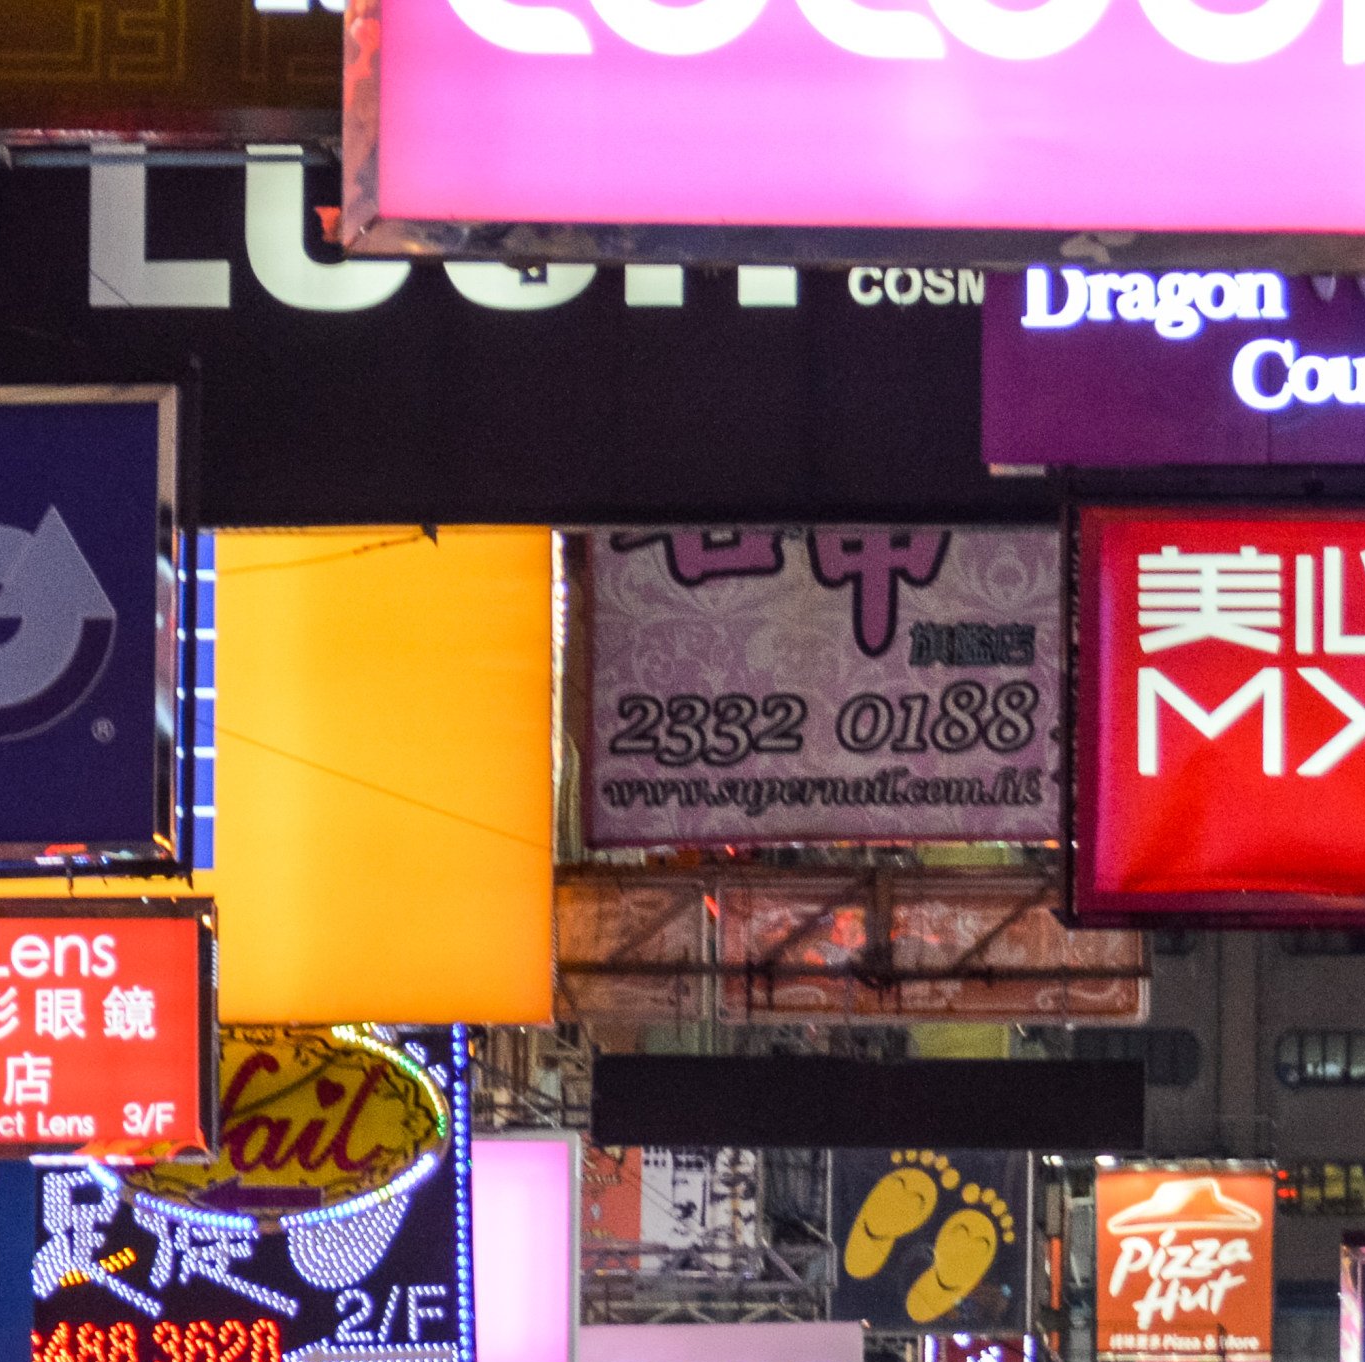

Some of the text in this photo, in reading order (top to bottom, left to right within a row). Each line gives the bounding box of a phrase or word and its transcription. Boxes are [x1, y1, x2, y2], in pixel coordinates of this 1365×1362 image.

[1021, 265, 1288, 338] Dragon
[609, 680, 1039, 766] 2332 0188
[37, 1111, 95, 1138] Lens
[122, 1103, 176, 1136] 3/F
[1108, 1226, 1253, 1298] Pizza
[334, 1285, 447, 1344] 2/F
[1132, 1268, 1247, 1331] Hut
